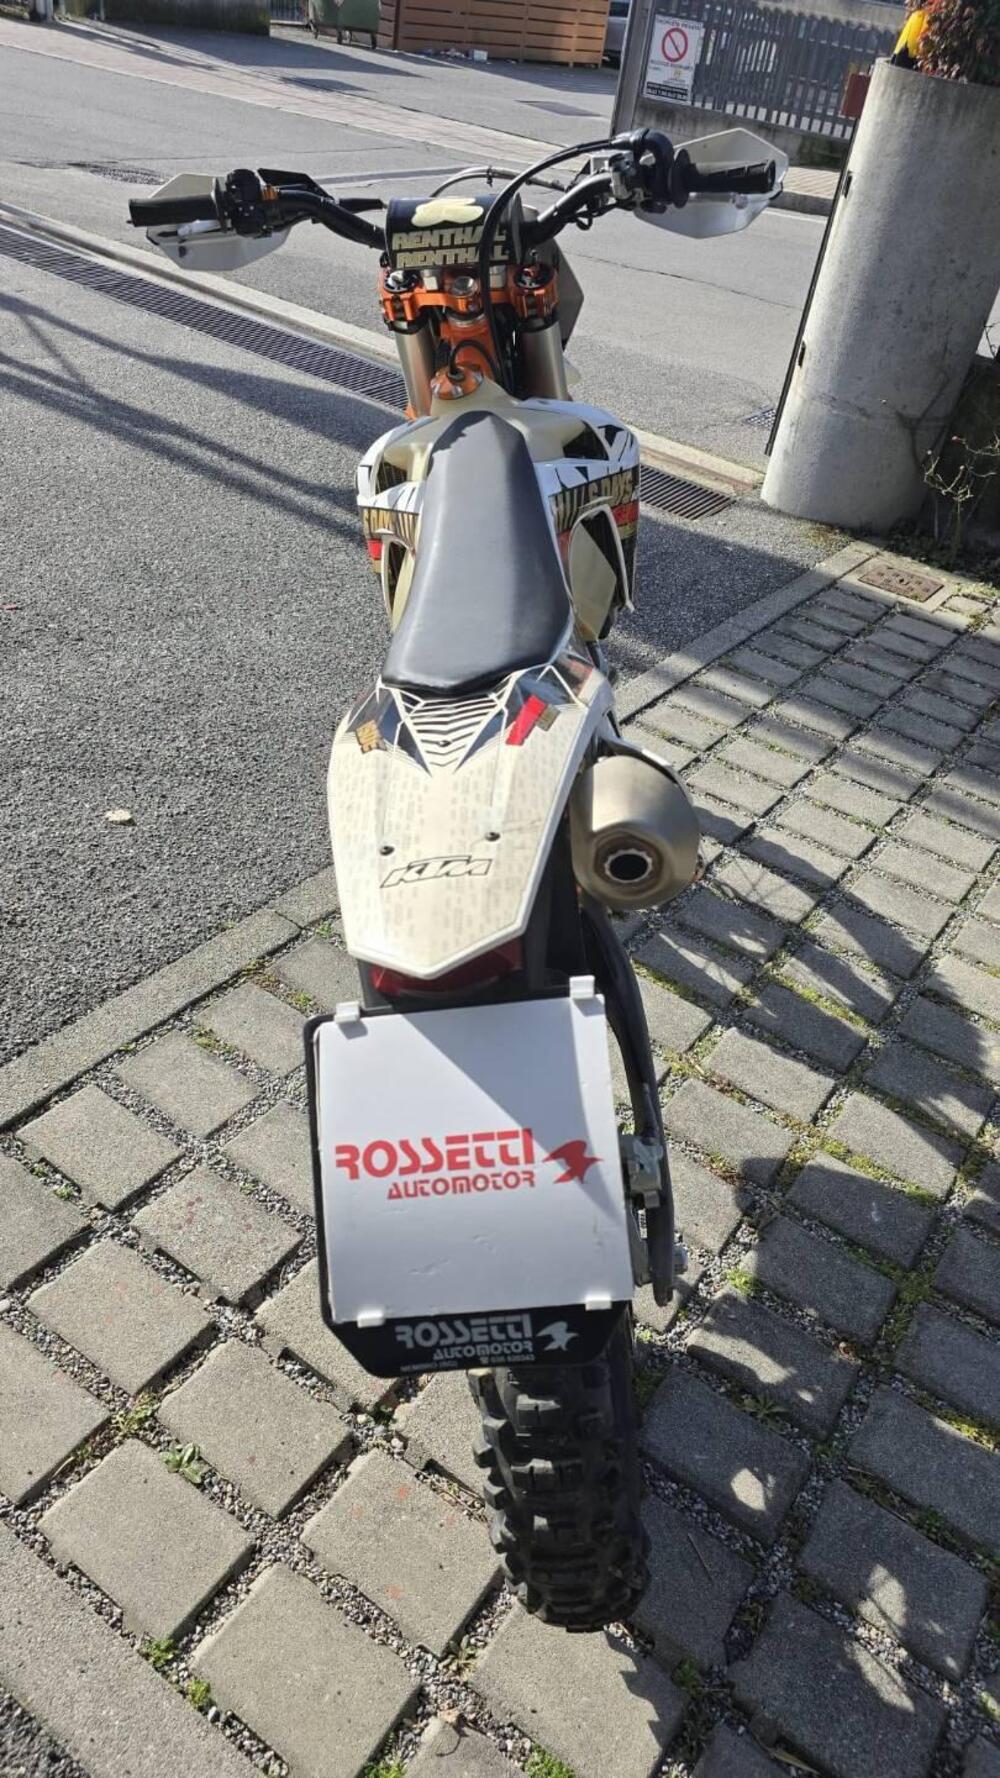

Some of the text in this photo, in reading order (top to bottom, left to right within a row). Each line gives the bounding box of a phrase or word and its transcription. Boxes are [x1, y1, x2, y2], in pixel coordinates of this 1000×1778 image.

[380, 855, 492, 888] KTM
[335, 1128, 535, 1180] ROSSETTI
[387, 1170, 535, 1200] AUTOMOTOR
[395, 1313, 532, 1348] ROSSETTI
[433, 1340, 533, 1361] AUTOMOTOR
